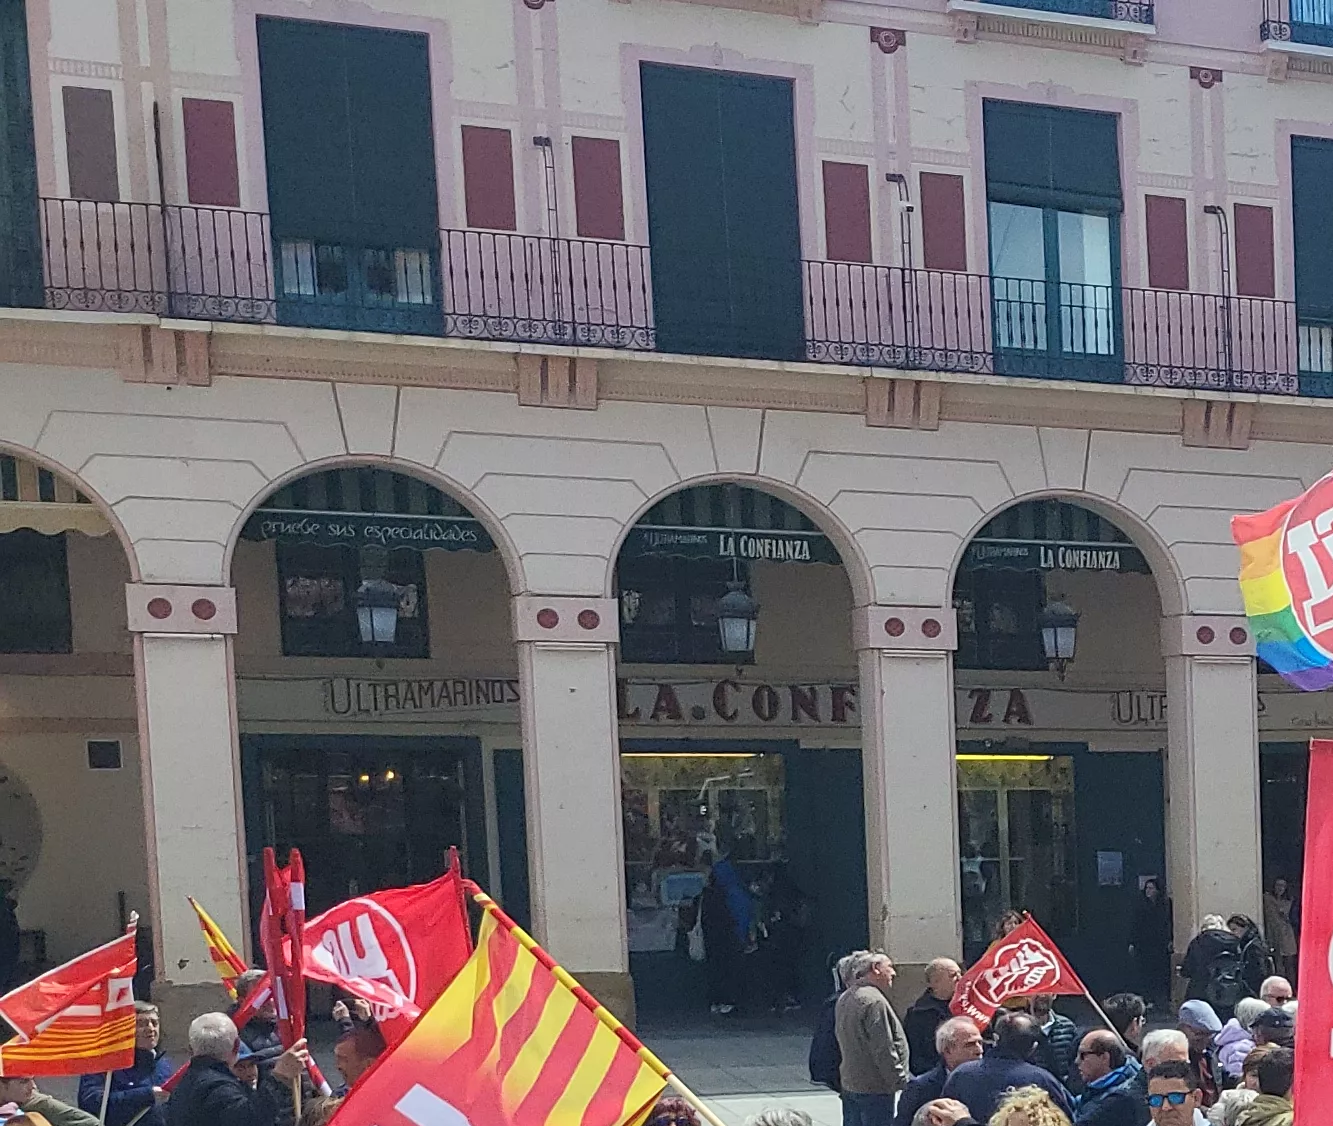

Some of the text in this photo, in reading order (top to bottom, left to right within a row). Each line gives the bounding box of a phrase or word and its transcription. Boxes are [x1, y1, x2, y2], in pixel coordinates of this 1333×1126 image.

[328, 523, 355, 537] sus
[364, 526, 477, 545] especialidades
[719, 534, 735, 556] LA
[739, 536, 810, 560] CONFIANZA
[1040, 546, 1054, 568] LA
[1058, 547, 1120, 569] CONFIANZA
[330, 677, 521, 714] ULTRAMARINOS
